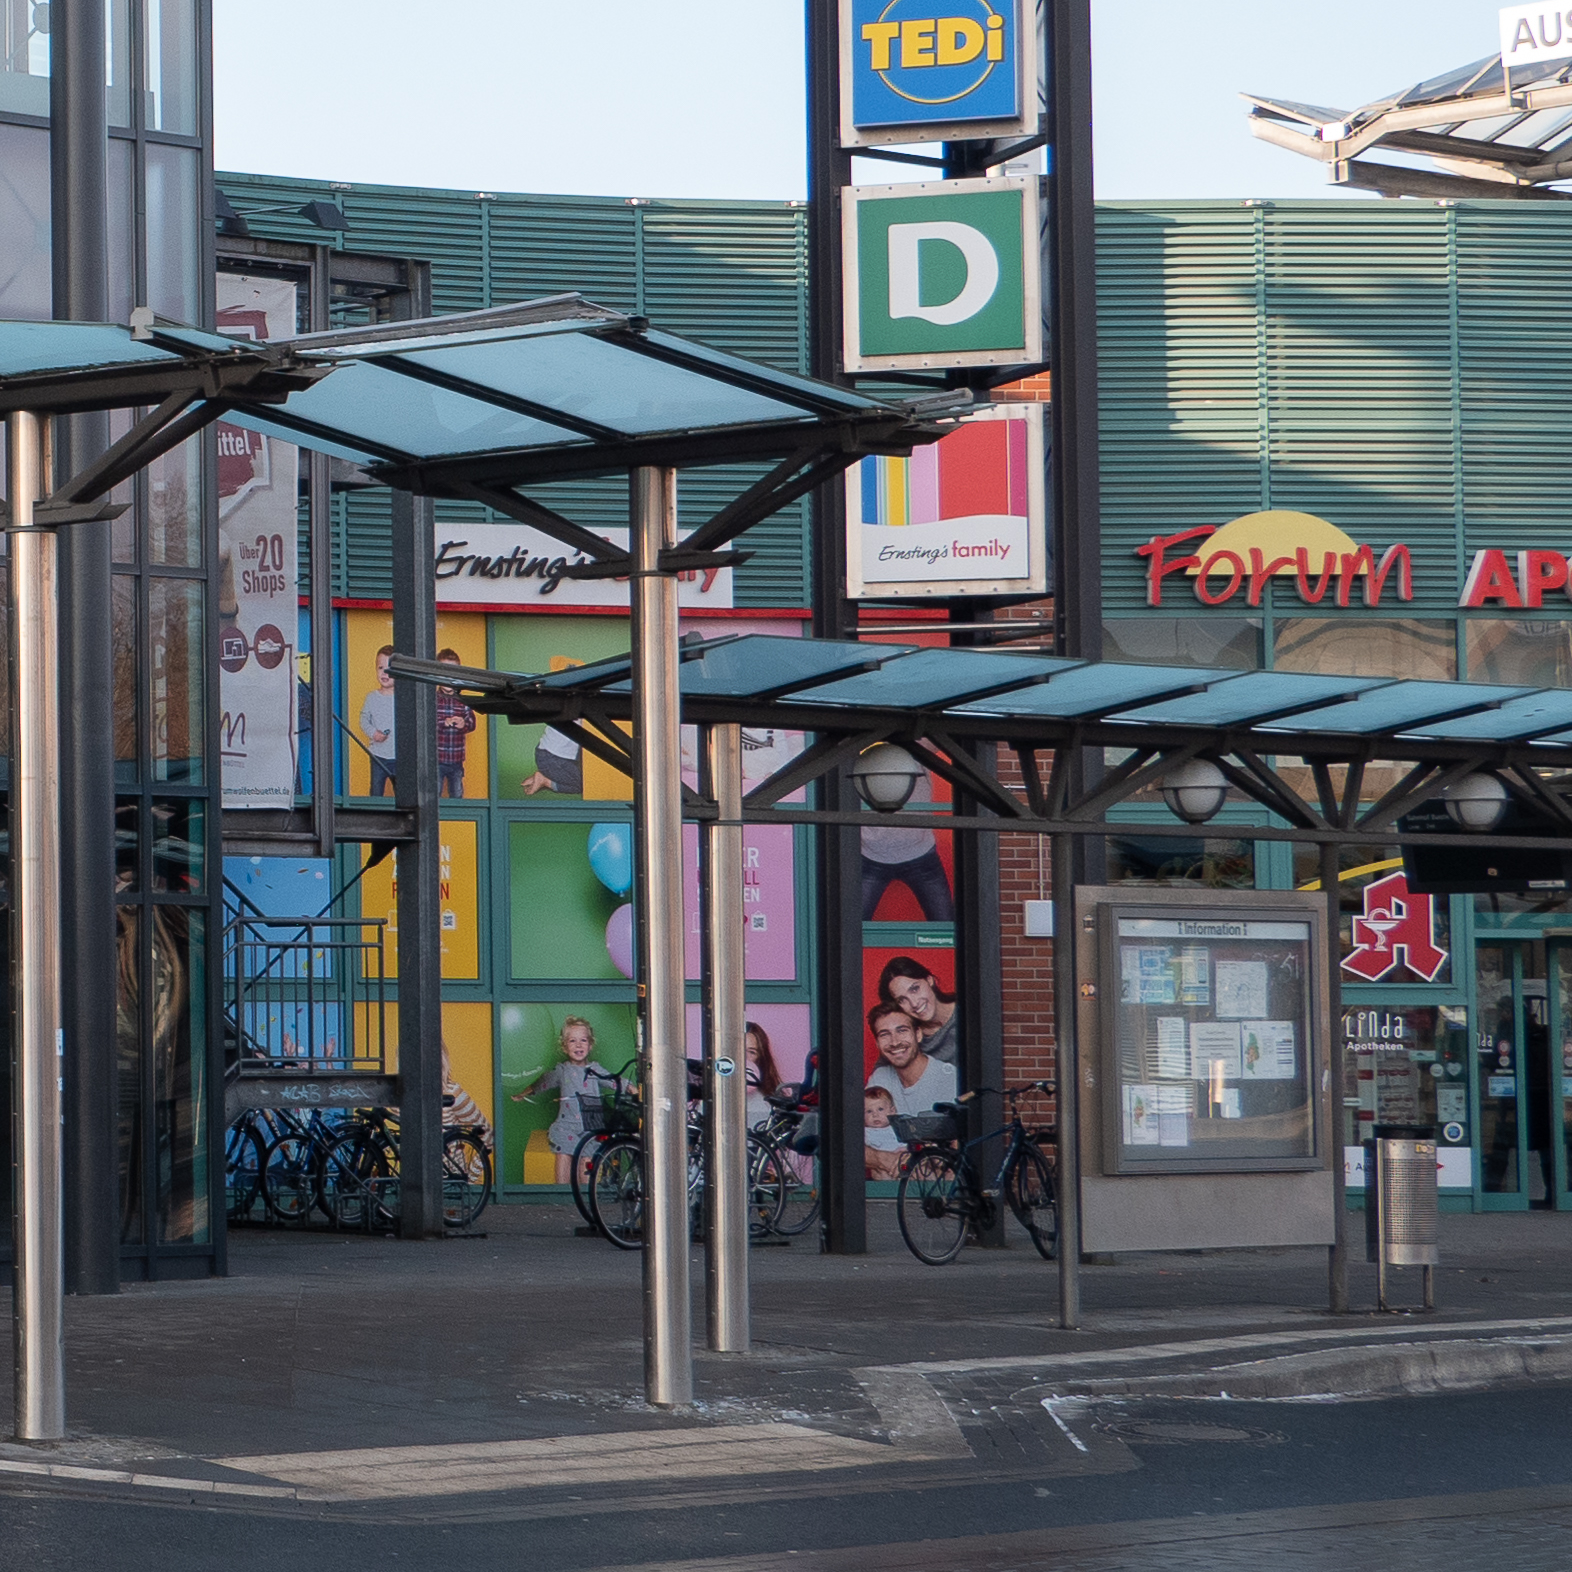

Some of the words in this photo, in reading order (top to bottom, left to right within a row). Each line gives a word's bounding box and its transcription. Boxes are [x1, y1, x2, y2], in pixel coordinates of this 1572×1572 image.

[861, 14, 1005, 71] TEDi
[888, 221, 999, 326] D
[239, 542, 260, 560] Über
[256, 533, 284, 573] 20
[878, 544, 949, 565] Ernsting's
[952, 538, 1011, 560] family
[1134, 524, 1413, 608] Forum
[1457, 548, 1572, 609] AP
[242, 569, 286, 599] Shops
[1184, 922, 1242, 937] Information
[1346, 1041, 1404, 1052] Apotheken
